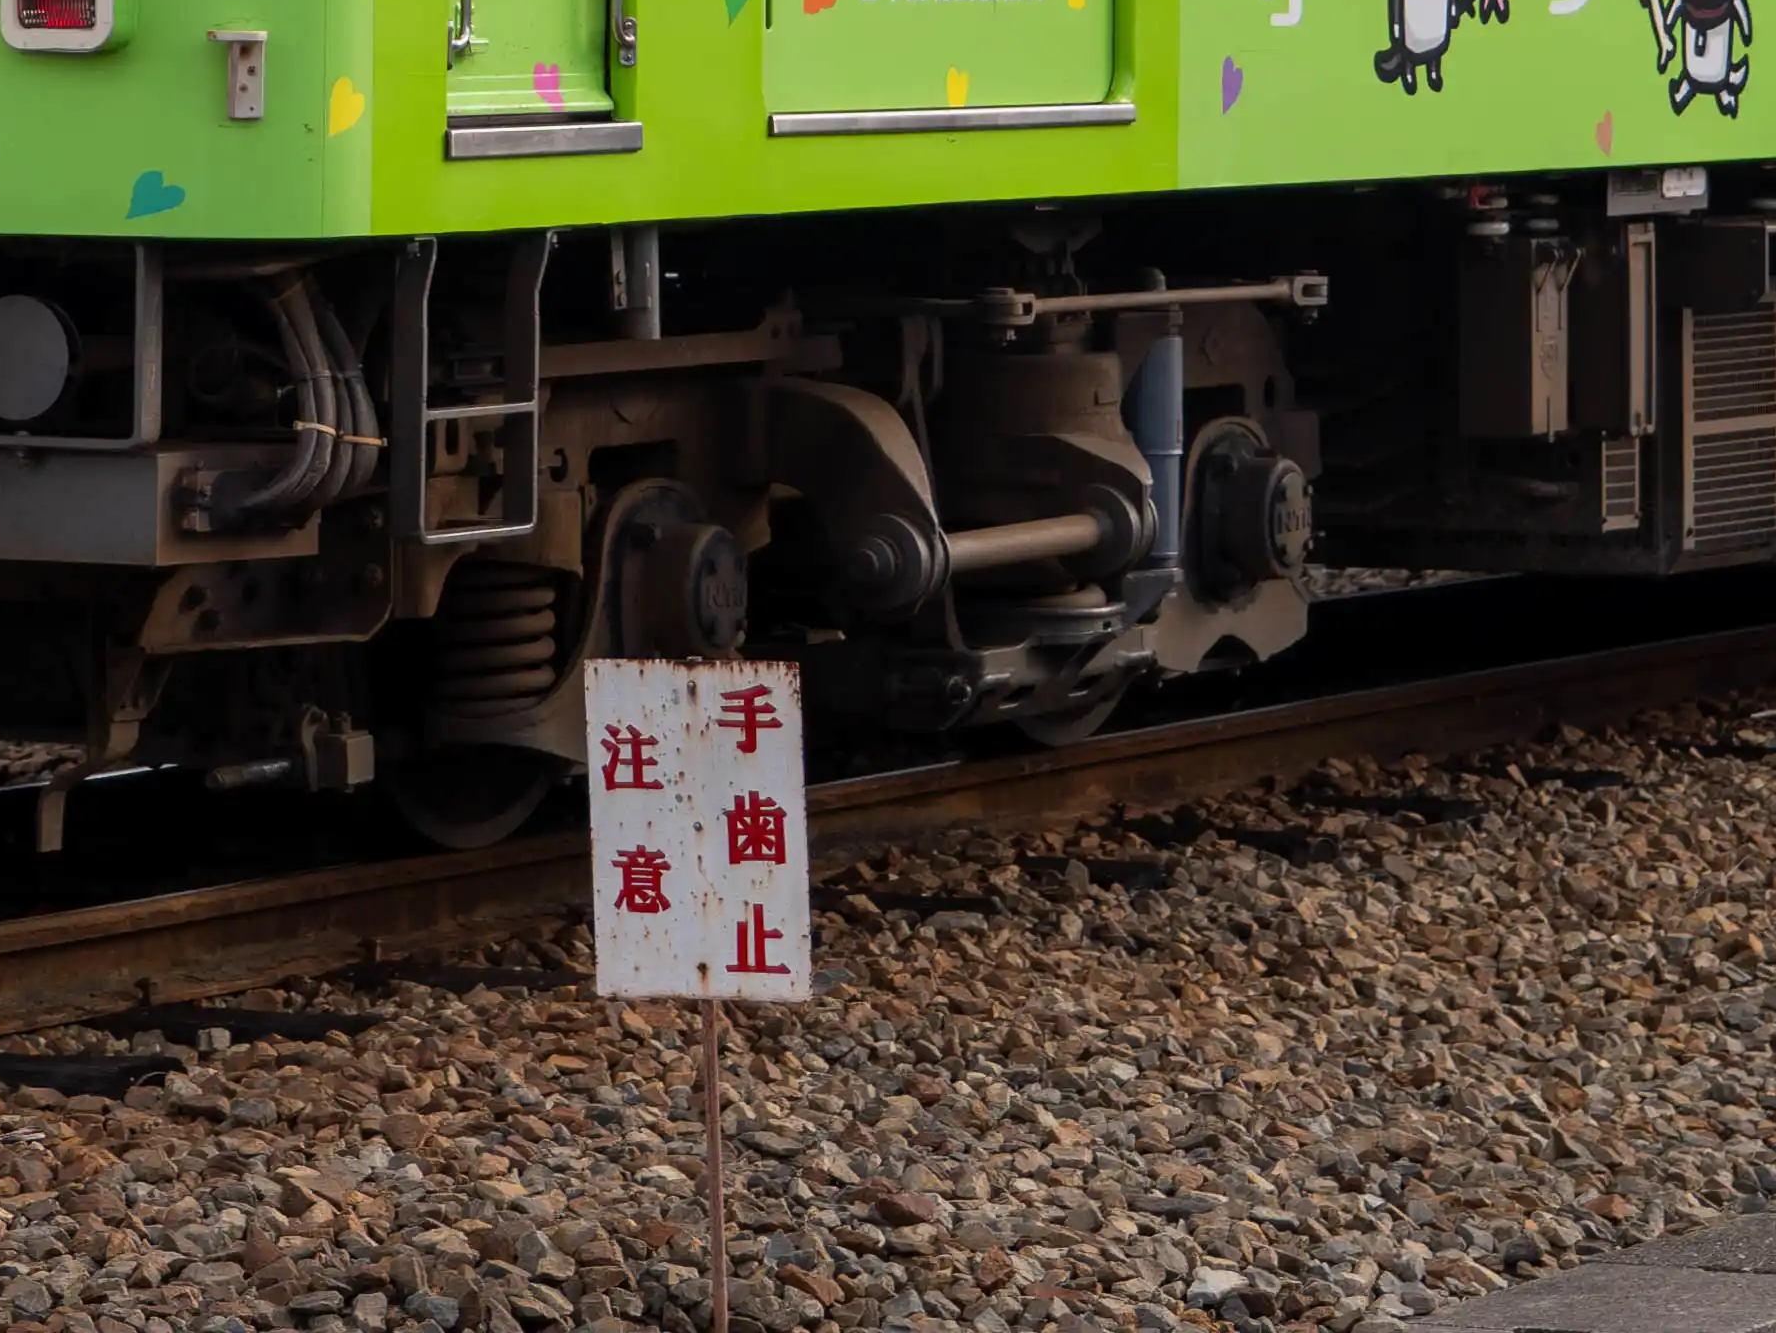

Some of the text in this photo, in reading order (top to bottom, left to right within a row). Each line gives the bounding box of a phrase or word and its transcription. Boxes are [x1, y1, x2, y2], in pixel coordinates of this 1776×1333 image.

[599, 723, 672, 914] 注意
[715, 683, 791, 975] 手歯止
